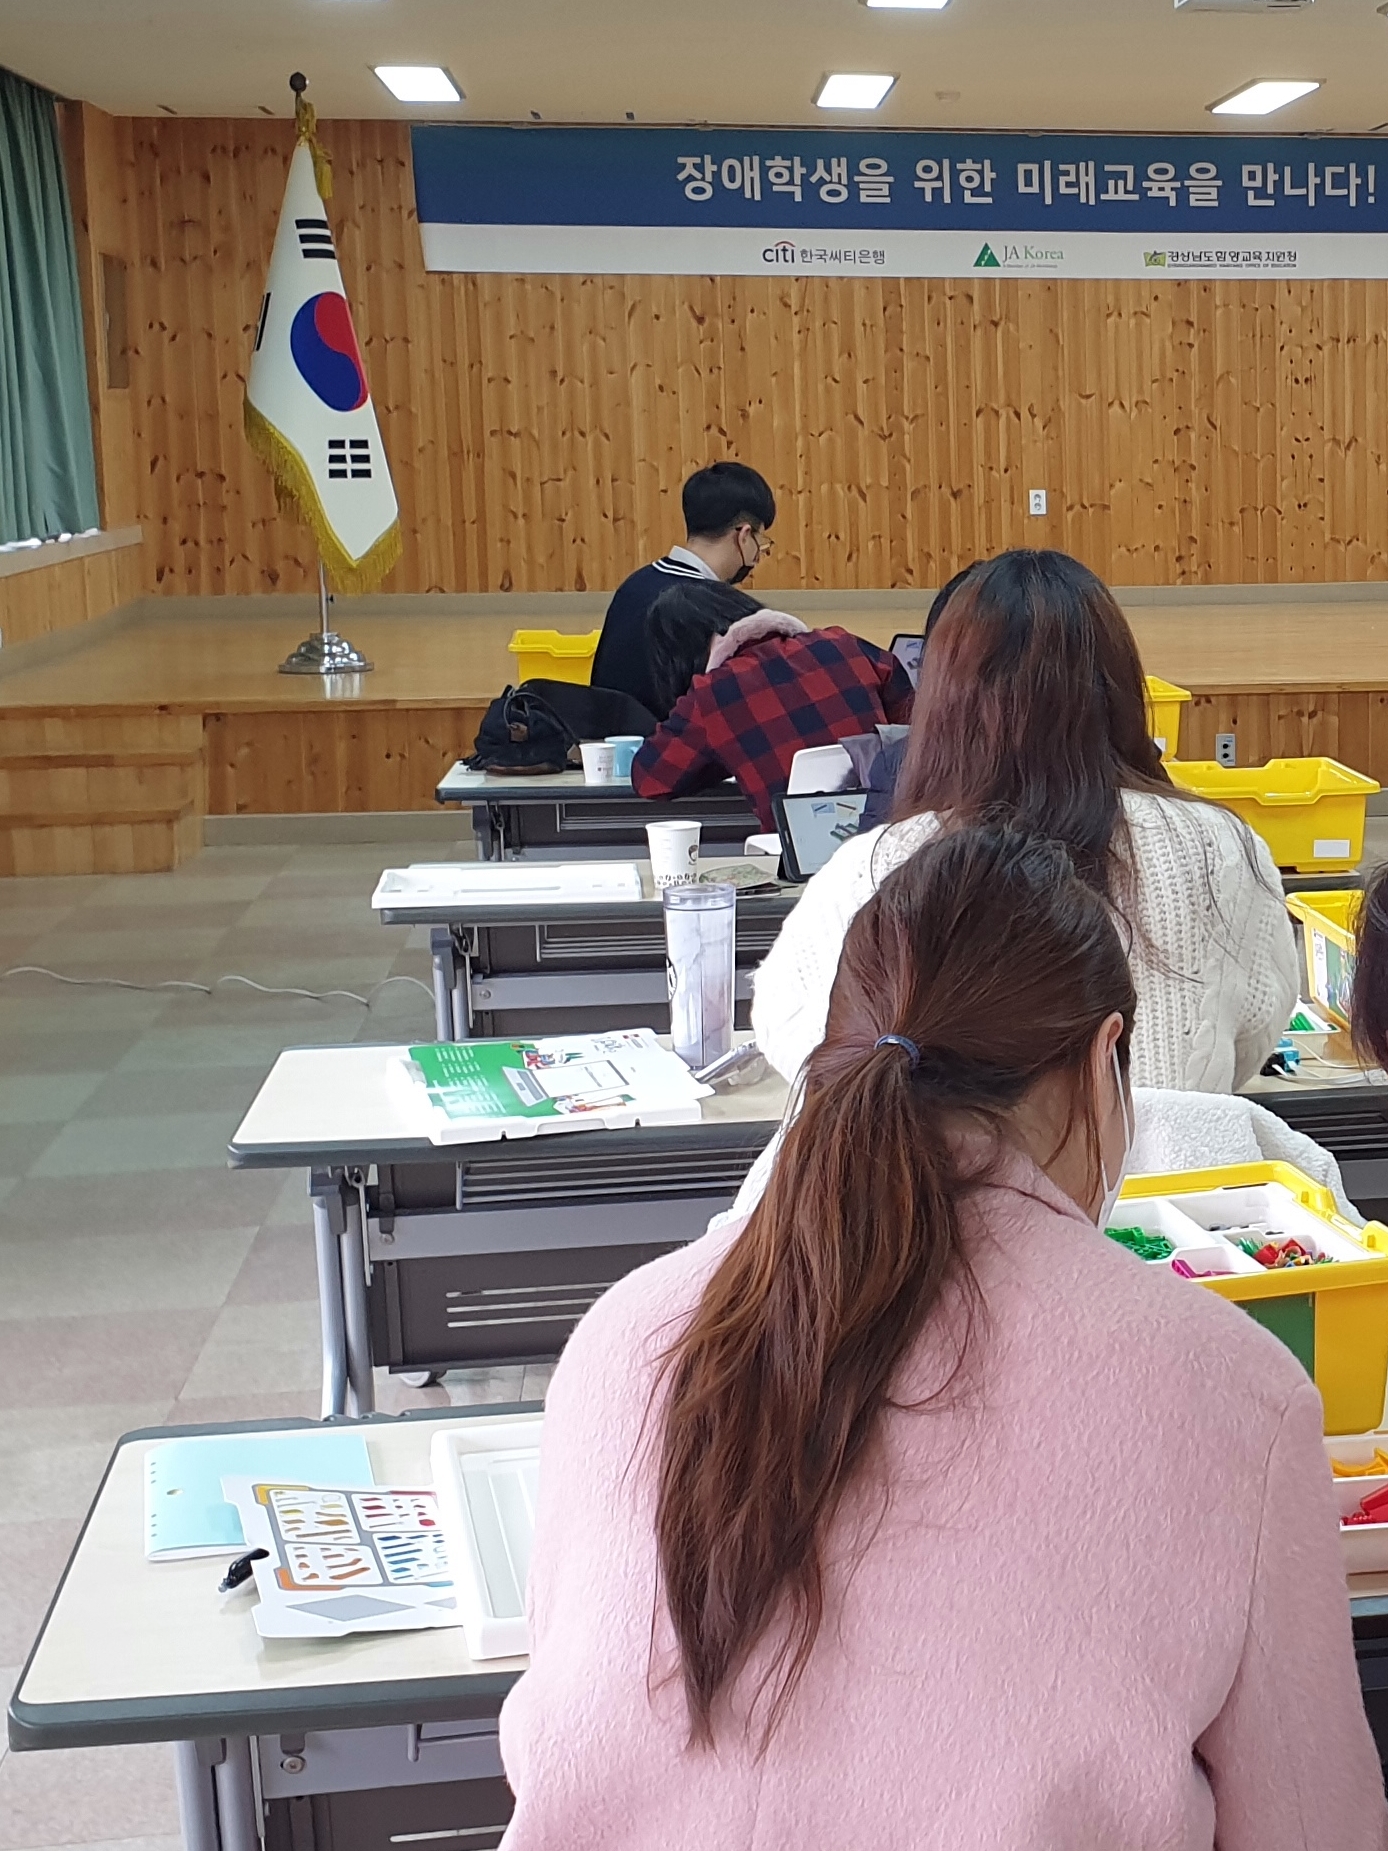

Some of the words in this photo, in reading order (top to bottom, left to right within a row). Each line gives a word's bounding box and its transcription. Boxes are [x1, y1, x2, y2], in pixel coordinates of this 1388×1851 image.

[676, 154, 895, 203] 장애학생을
[913, 158, 997, 204] 위한
[1017, 160, 1223, 207] 미래교육을
[1241, 162, 1376, 207] 만나다!
[762, 243, 795, 263] citi
[800, 248, 886, 265] 한국씨티은행
[1002, 245, 1020, 262] JA
[1024, 245, 1065, 260] Korea
